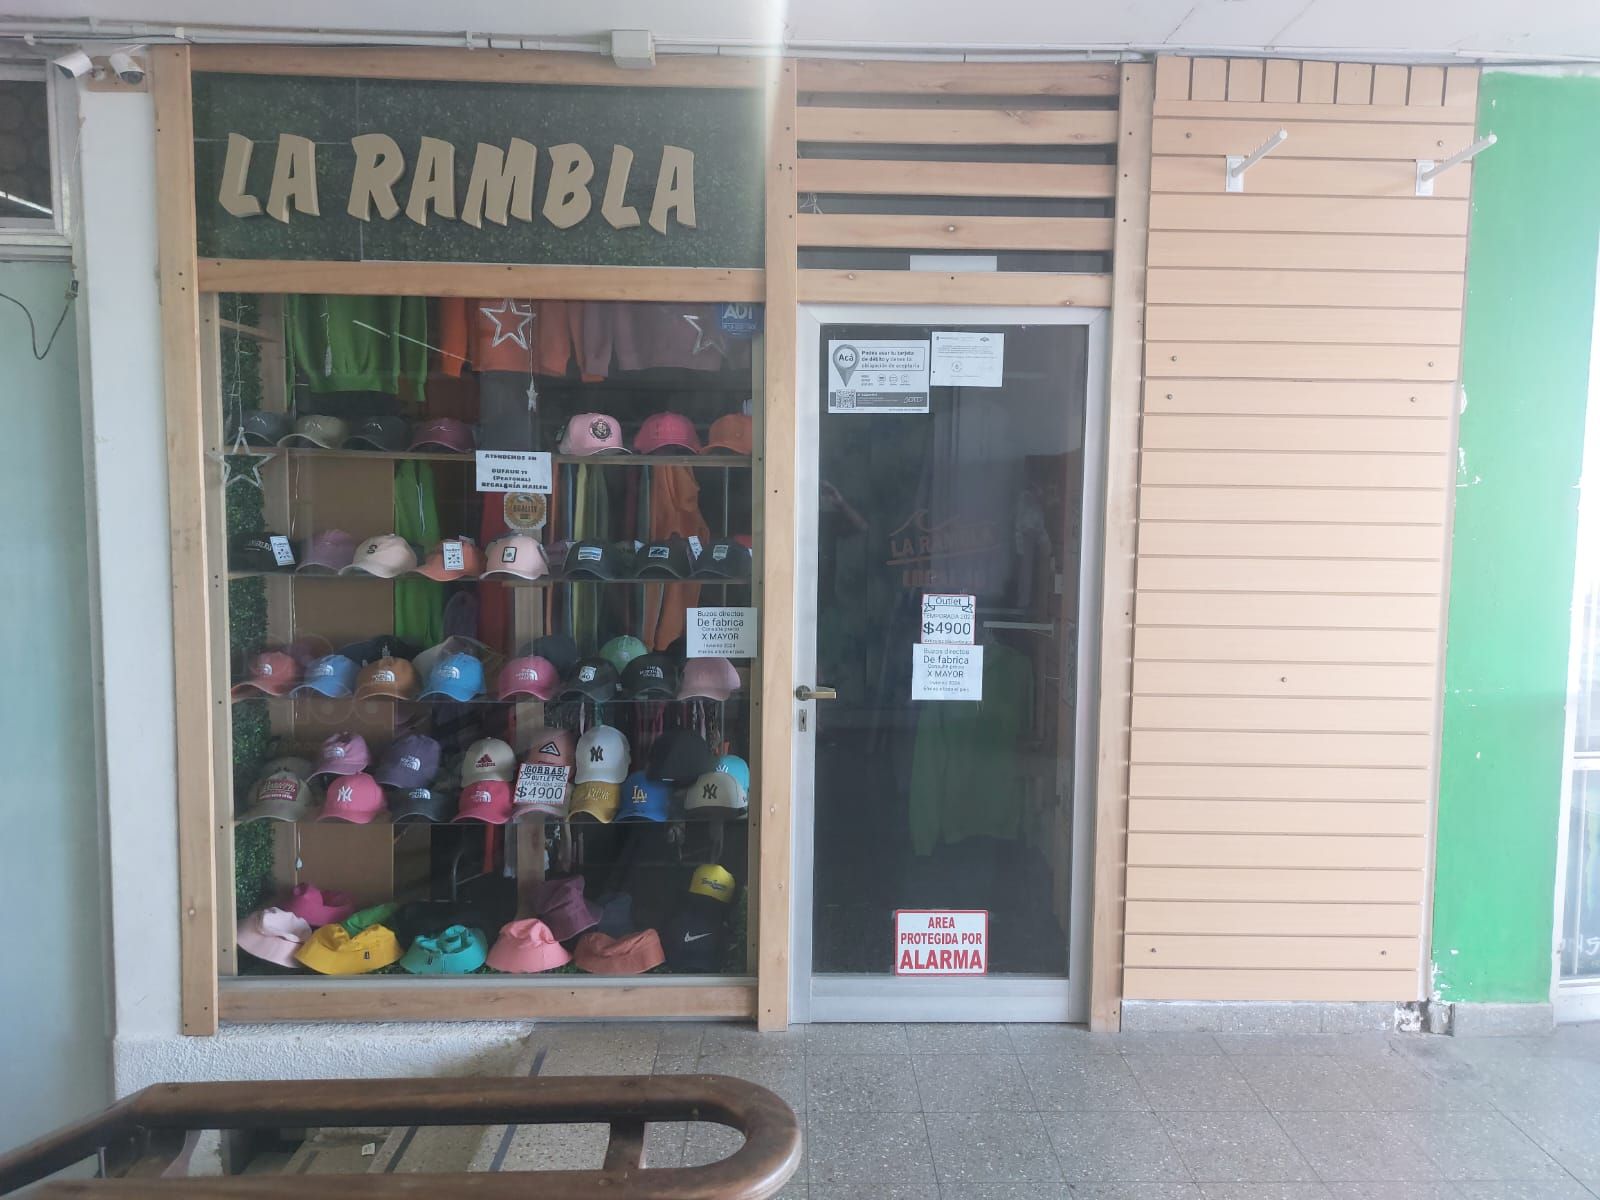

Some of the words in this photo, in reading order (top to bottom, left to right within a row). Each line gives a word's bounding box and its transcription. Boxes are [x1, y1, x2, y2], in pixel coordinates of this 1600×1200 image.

[218, 132, 320, 224] LA
[347, 133, 697, 235] RAMBLA
[838, 353, 854, 362] Acá
[935, 596, 961, 605] Outlet
[697, 618, 710, 627] De
[712, 617, 744, 627] fabrica
[923, 621, 971, 635] $4900
[701, 632, 708, 640] X
[709, 632, 739, 640] MAYOR
[923, 655, 936, 664] De
[938, 655, 969, 664] fabrica
[934, 670, 964, 678] MAYOR
[526, 765, 562, 775] GORRAS
[515, 783, 563, 799] $4900
[928, 916, 956, 929] AREA
[900, 932, 959, 945] PROTEGIDA
[961, 932, 982, 945] POR
[900, 949, 983, 969] ALARMA
